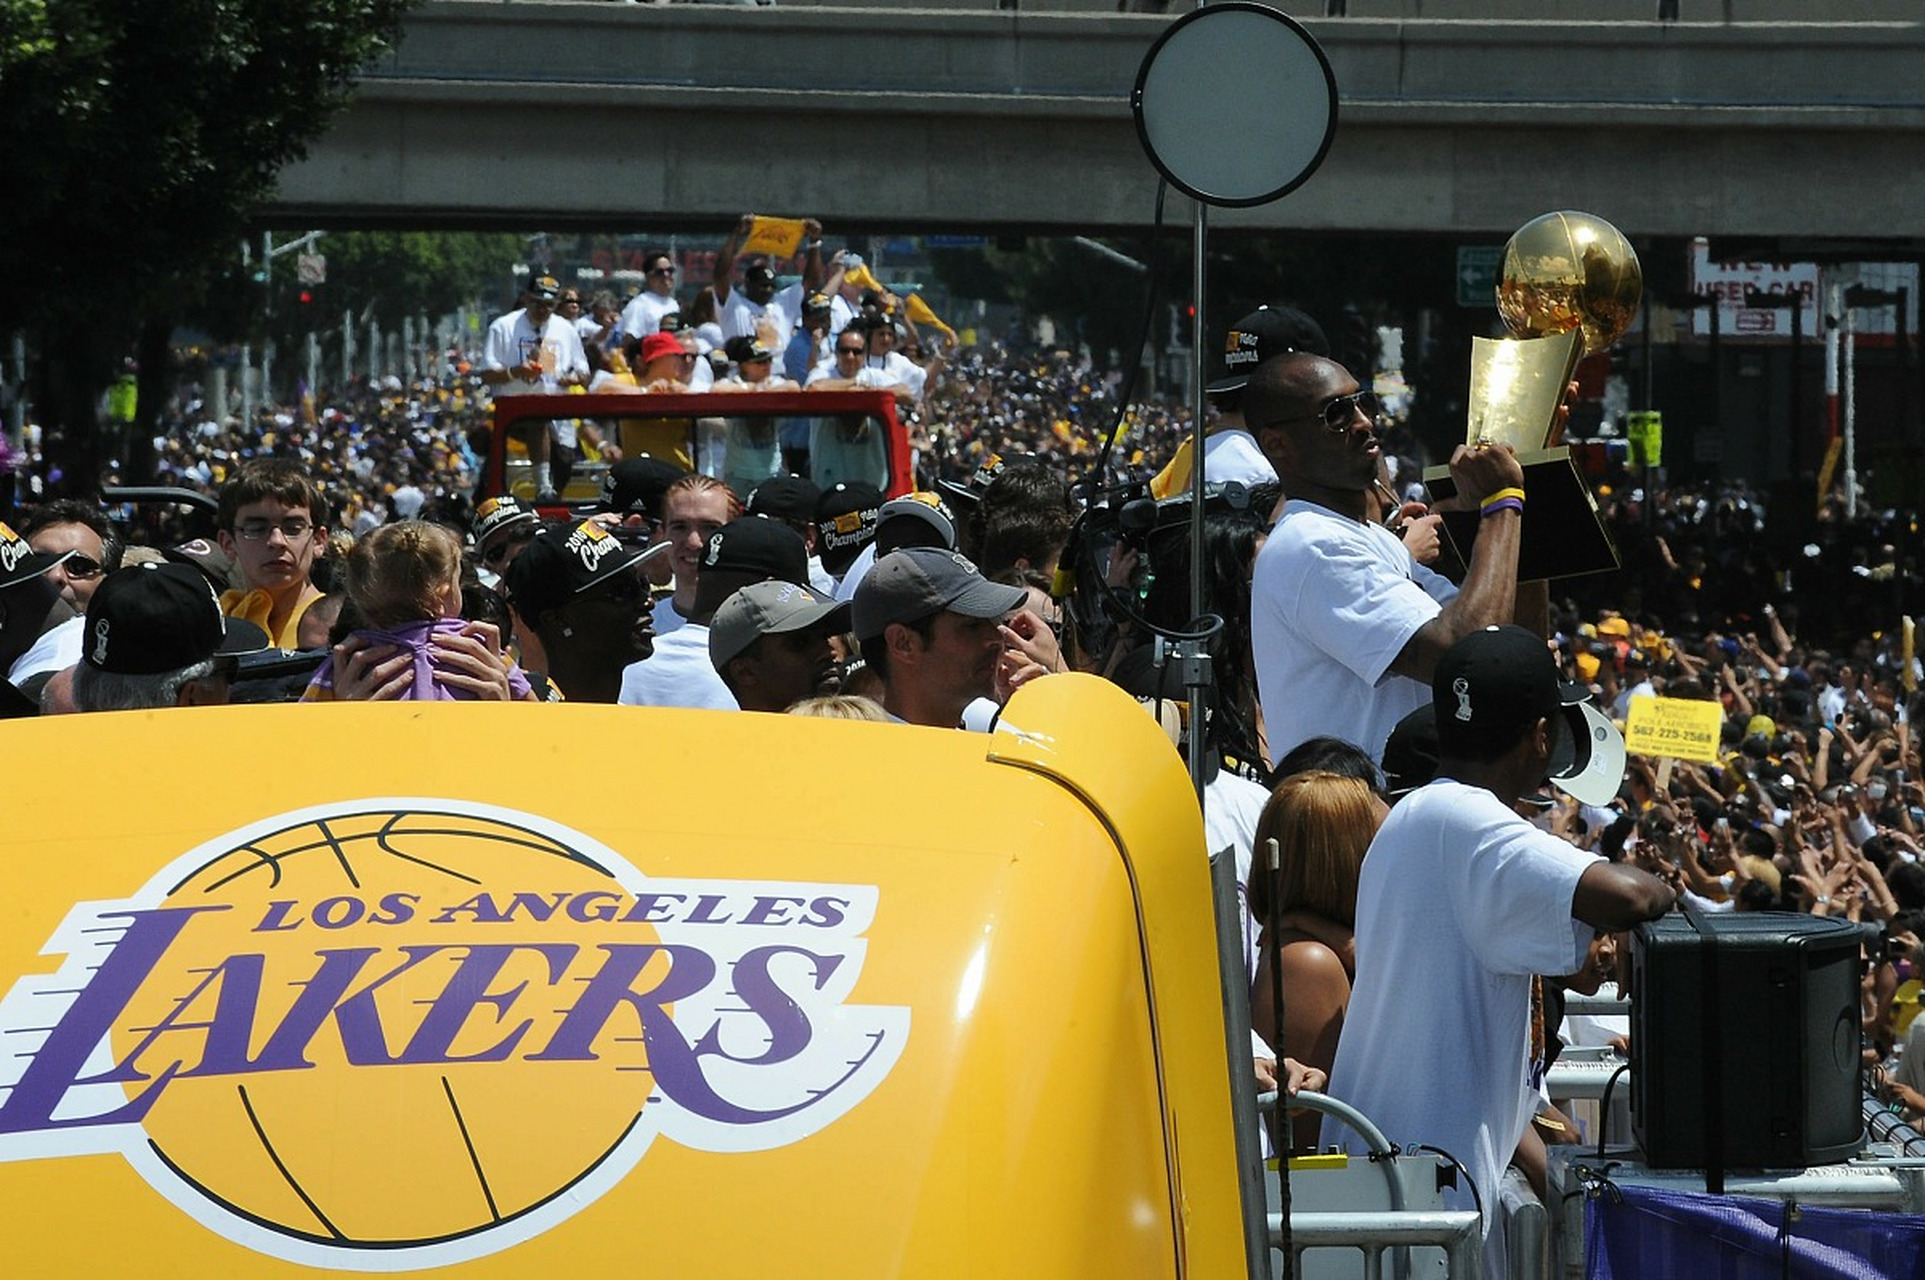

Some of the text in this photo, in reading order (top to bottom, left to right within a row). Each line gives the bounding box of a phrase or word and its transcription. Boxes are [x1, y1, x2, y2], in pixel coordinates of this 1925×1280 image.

[250, 892, 852, 933] LOS ANGELES
[0, 905, 886, 1134] LAKERS
